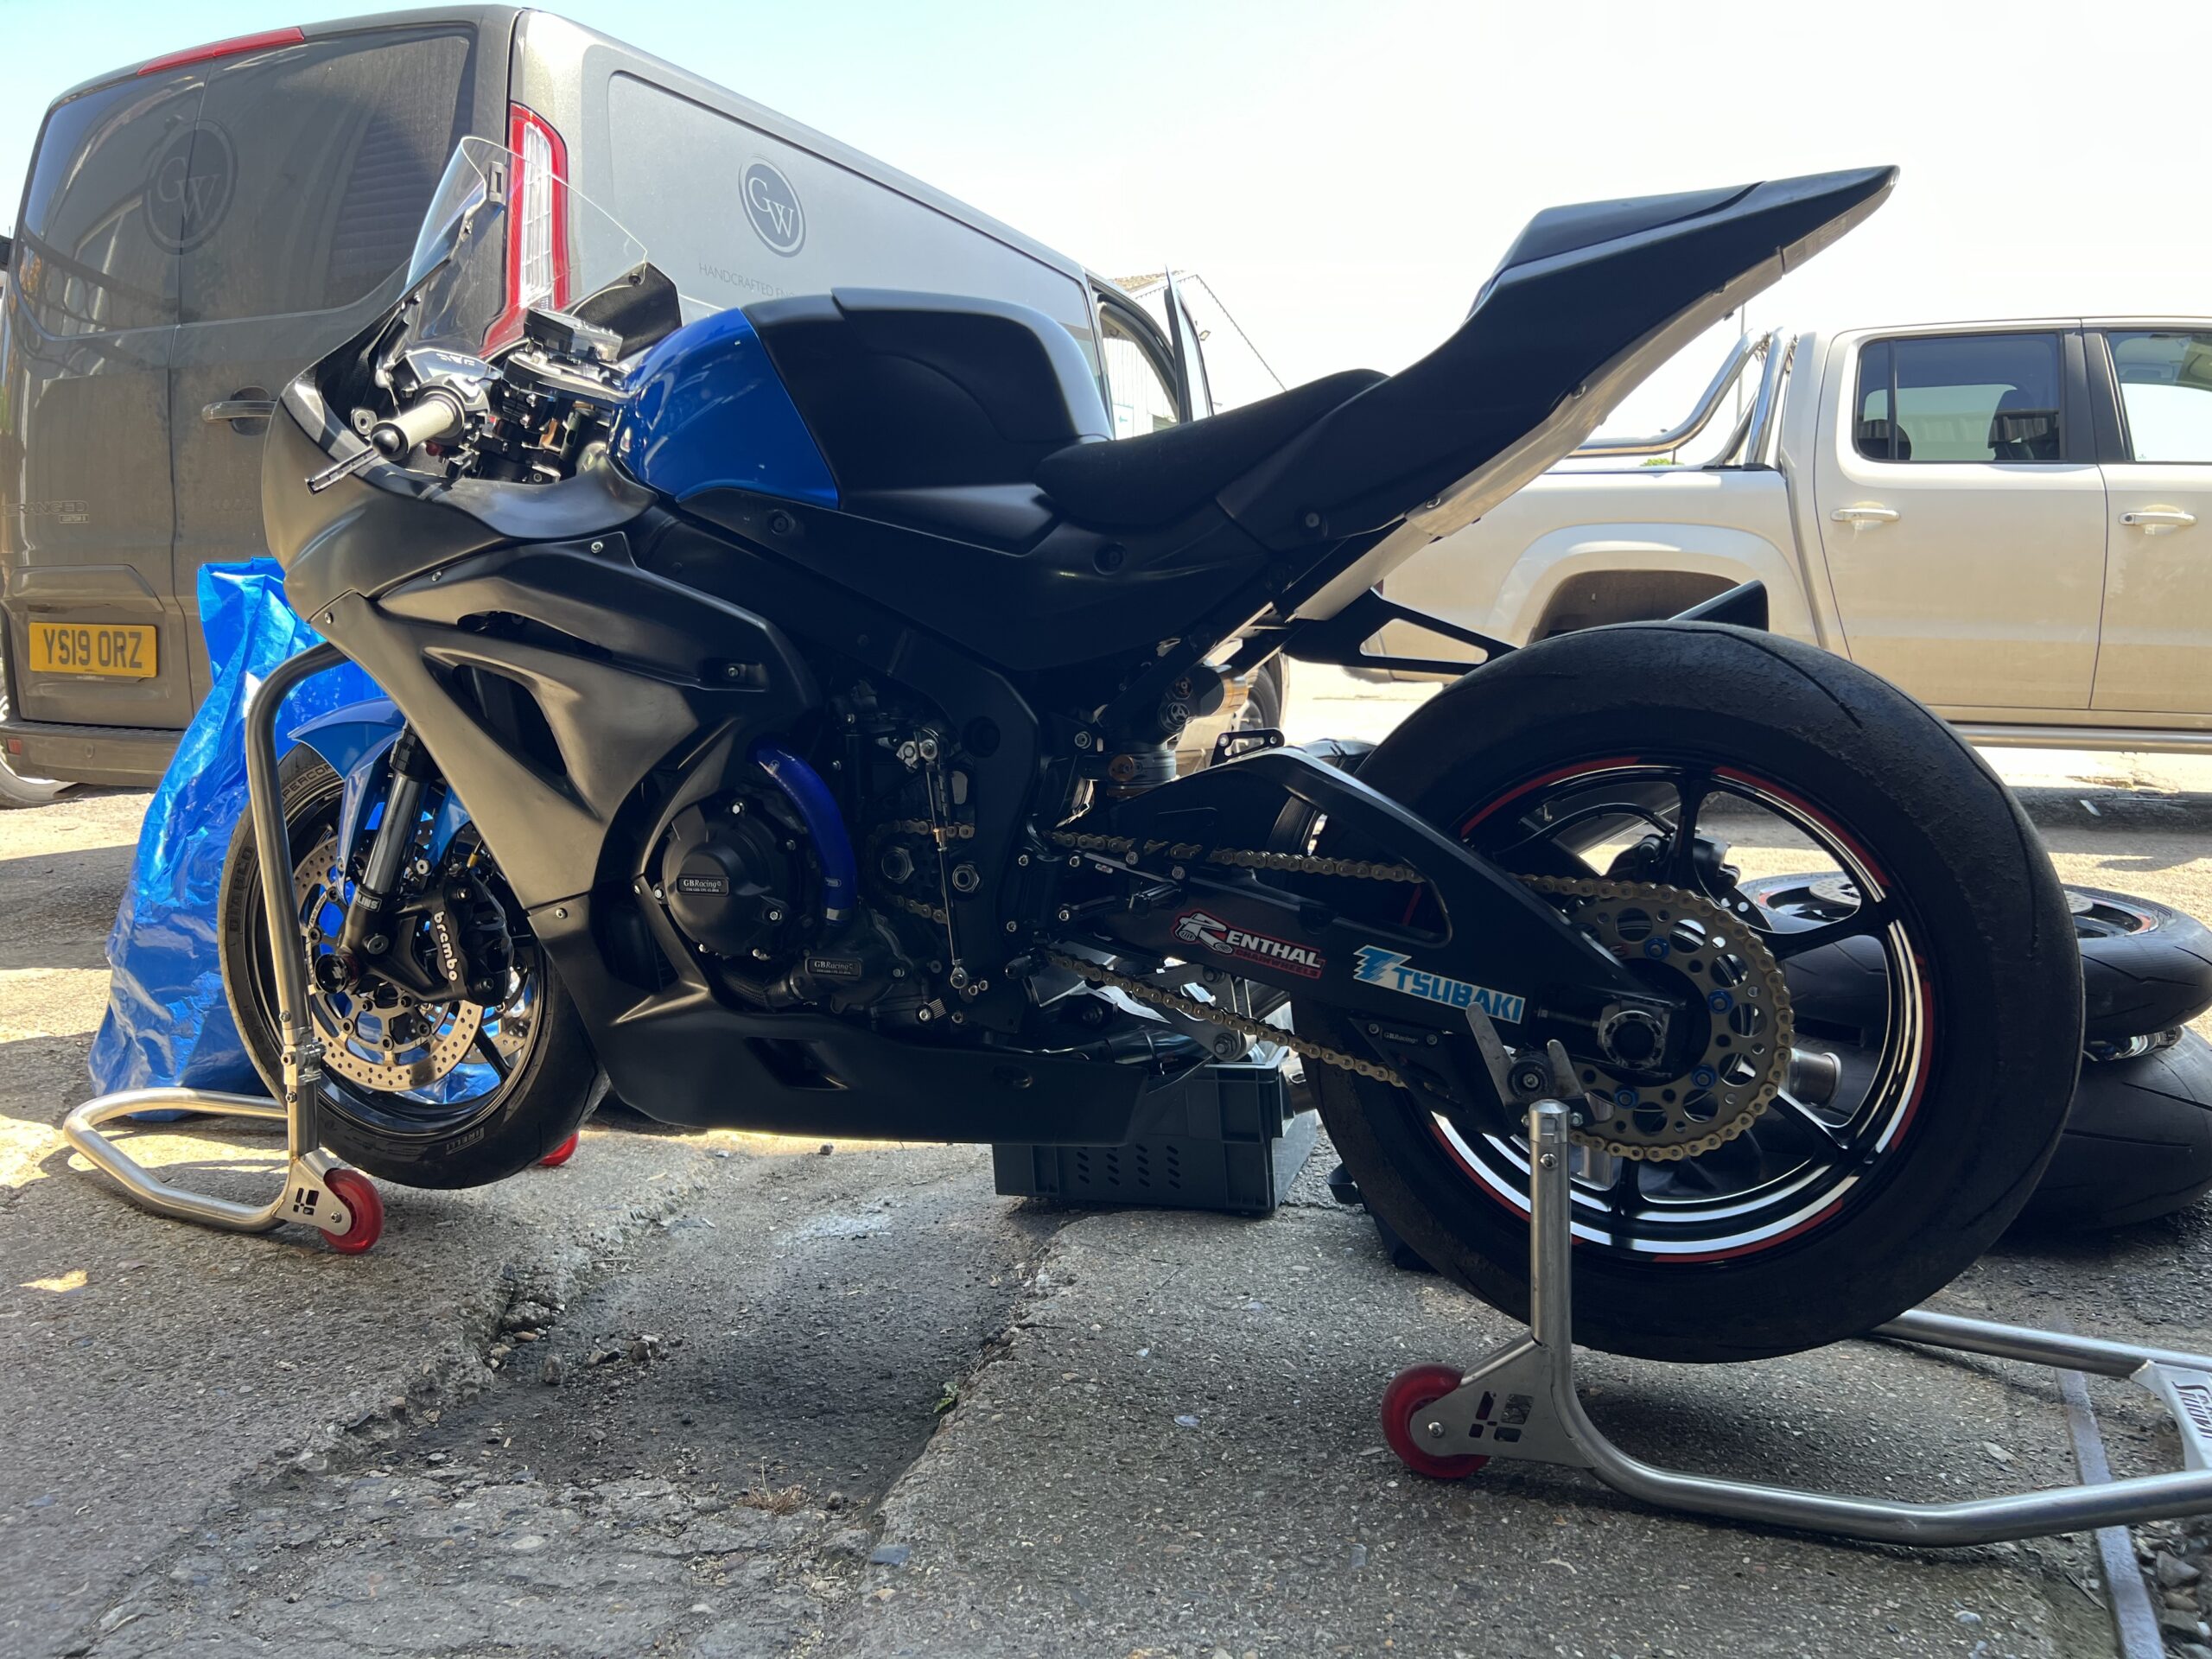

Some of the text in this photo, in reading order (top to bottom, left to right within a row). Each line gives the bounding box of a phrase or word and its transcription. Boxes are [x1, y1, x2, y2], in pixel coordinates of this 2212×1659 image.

[699, 262, 774, 296] HANDCRAFTED
[43, 629, 143, 668] YS19 ORZ
[434, 911, 458, 982] brembo
[1175, 912, 1321, 968] RENTHAL
[1392, 966, 1523, 1022] TSUBAKI
